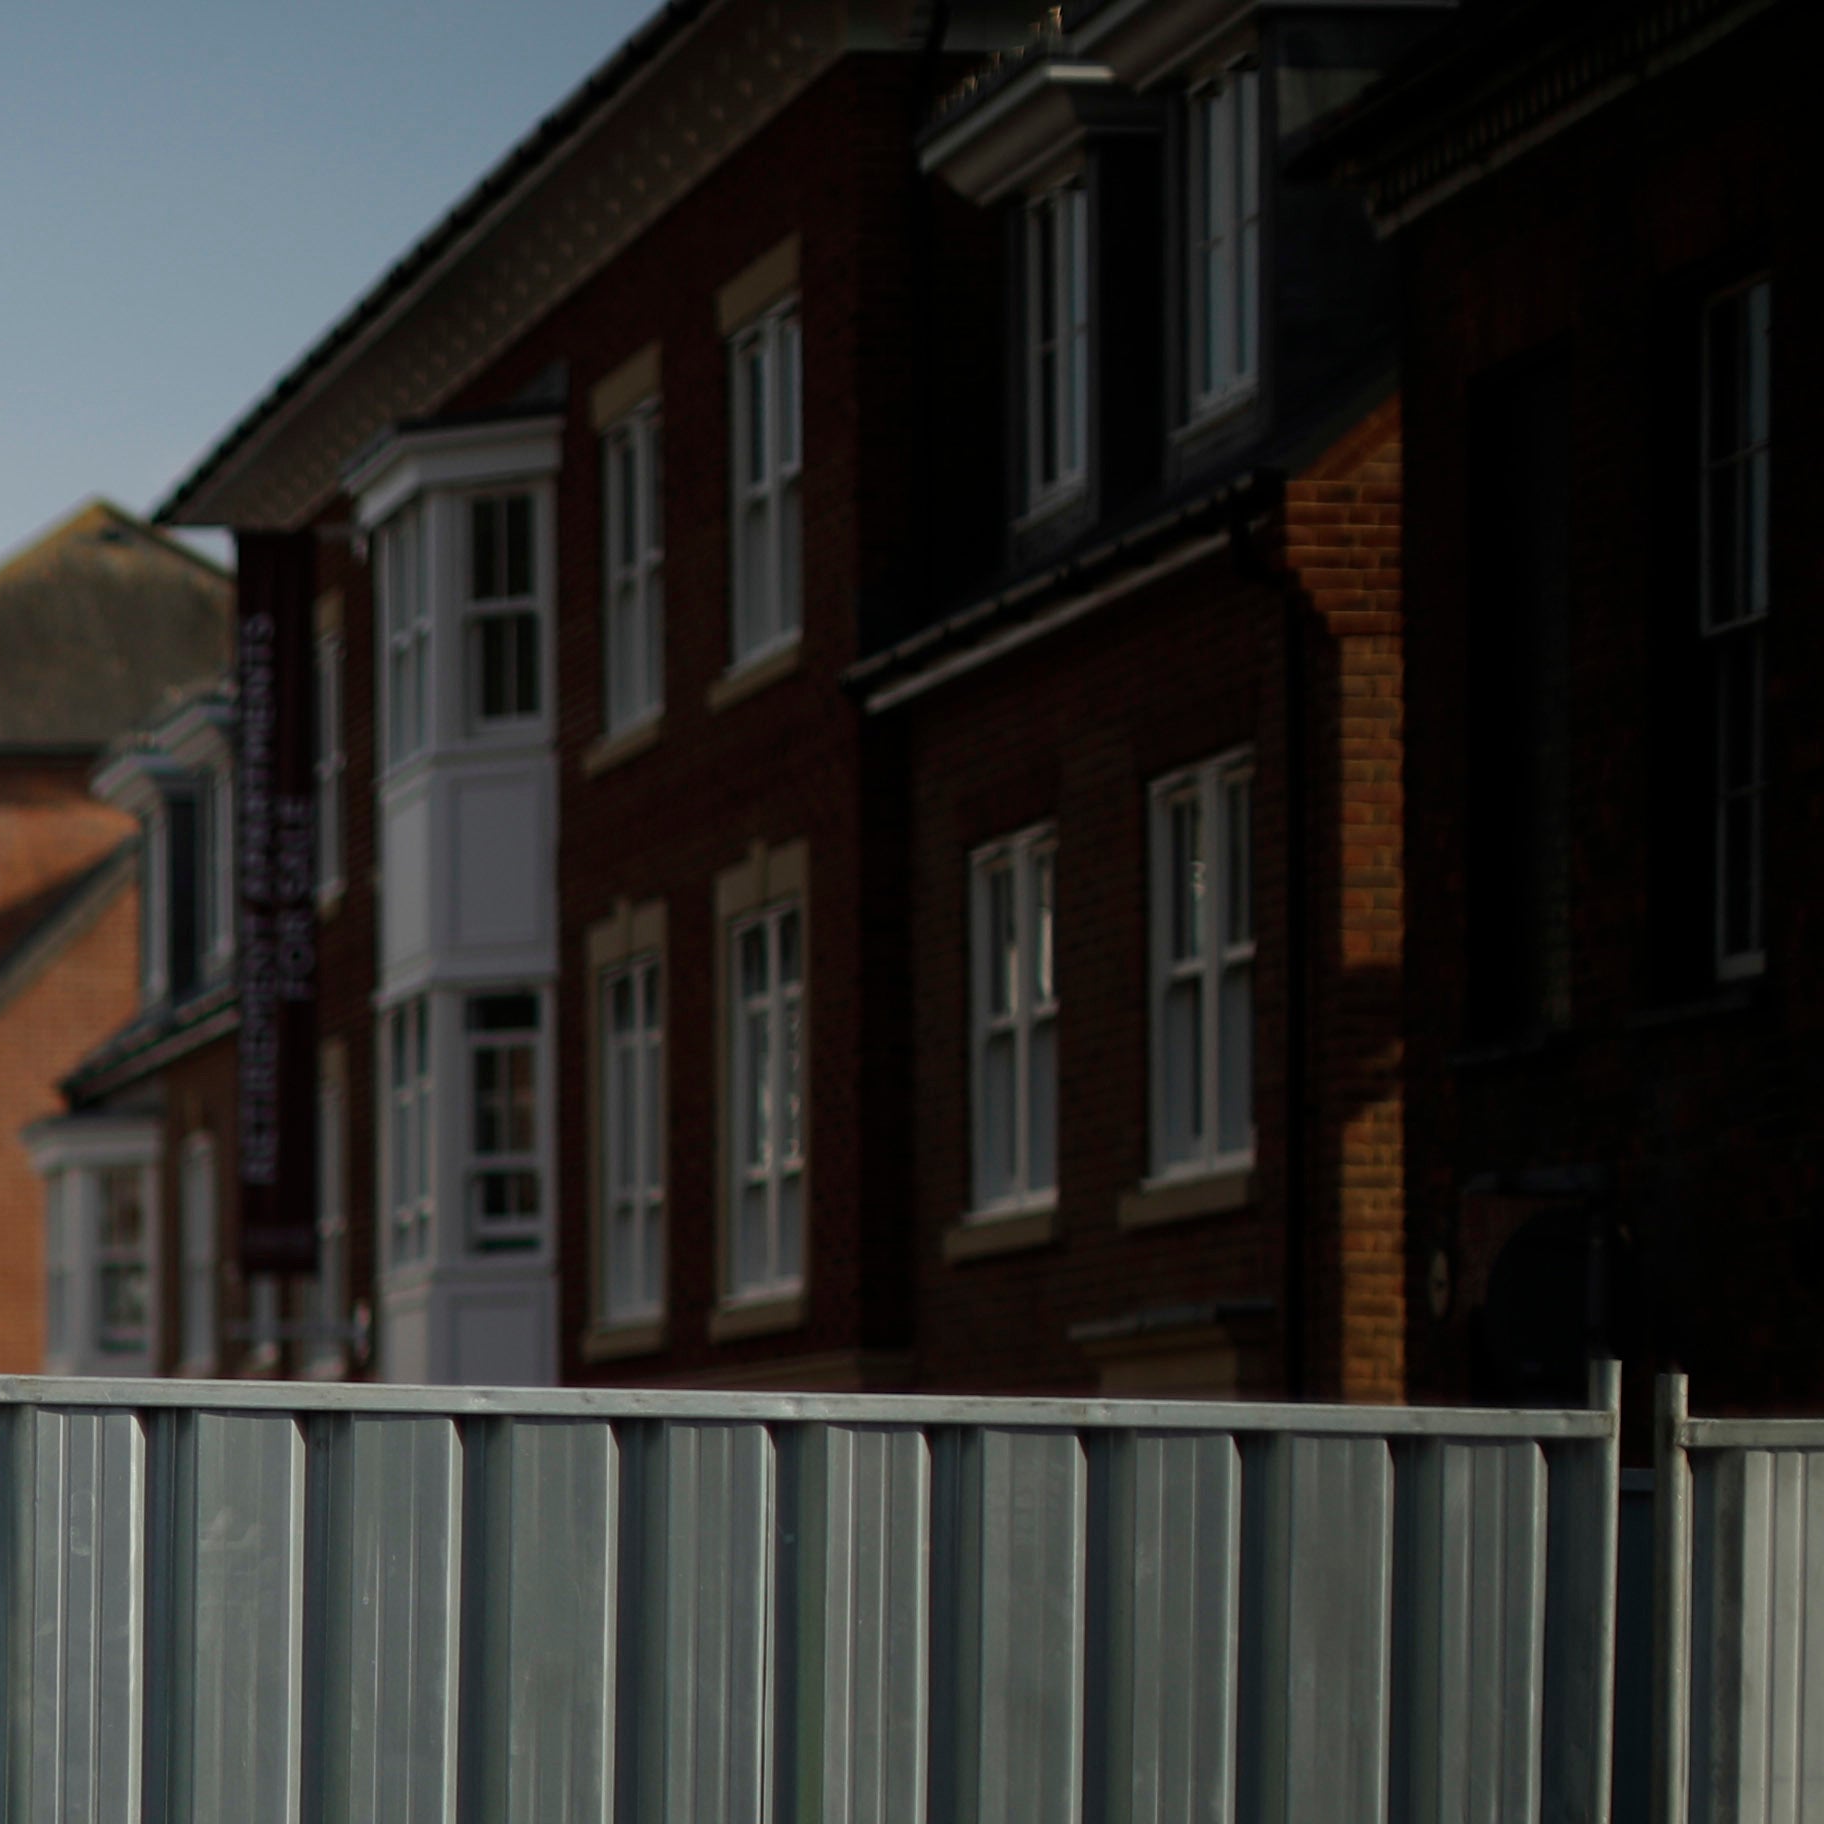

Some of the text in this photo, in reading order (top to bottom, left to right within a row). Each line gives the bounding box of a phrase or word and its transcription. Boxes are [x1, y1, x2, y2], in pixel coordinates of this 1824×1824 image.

[240, 611, 276, 902] APARTMENTS
[278, 795, 315, 1002] FOR SALE
[240, 911, 277, 1185] RETIREMENT
